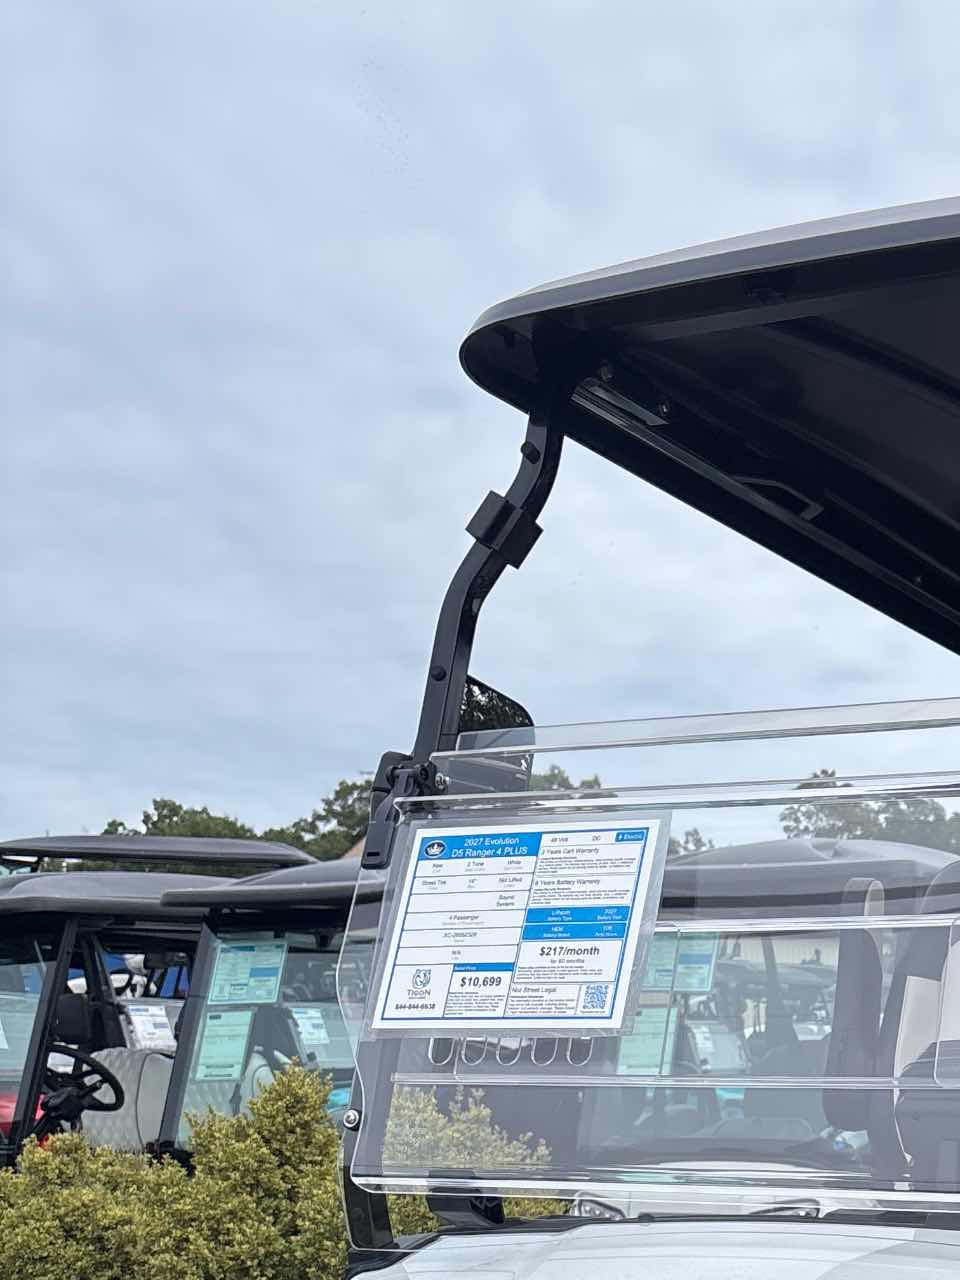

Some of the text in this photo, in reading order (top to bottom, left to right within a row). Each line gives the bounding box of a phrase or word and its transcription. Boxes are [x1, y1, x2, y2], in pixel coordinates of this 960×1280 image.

[464, 837, 520, 848] 2027 Evolution
[465, 847, 495, 858] Ranger
[495, 847, 501, 856] 4
[503, 846, 528, 856] PLUS
[539, 946, 600, 957] $217/month
[460, 976, 502, 988] $10,699
[407, 988, 432, 996] TIGON
